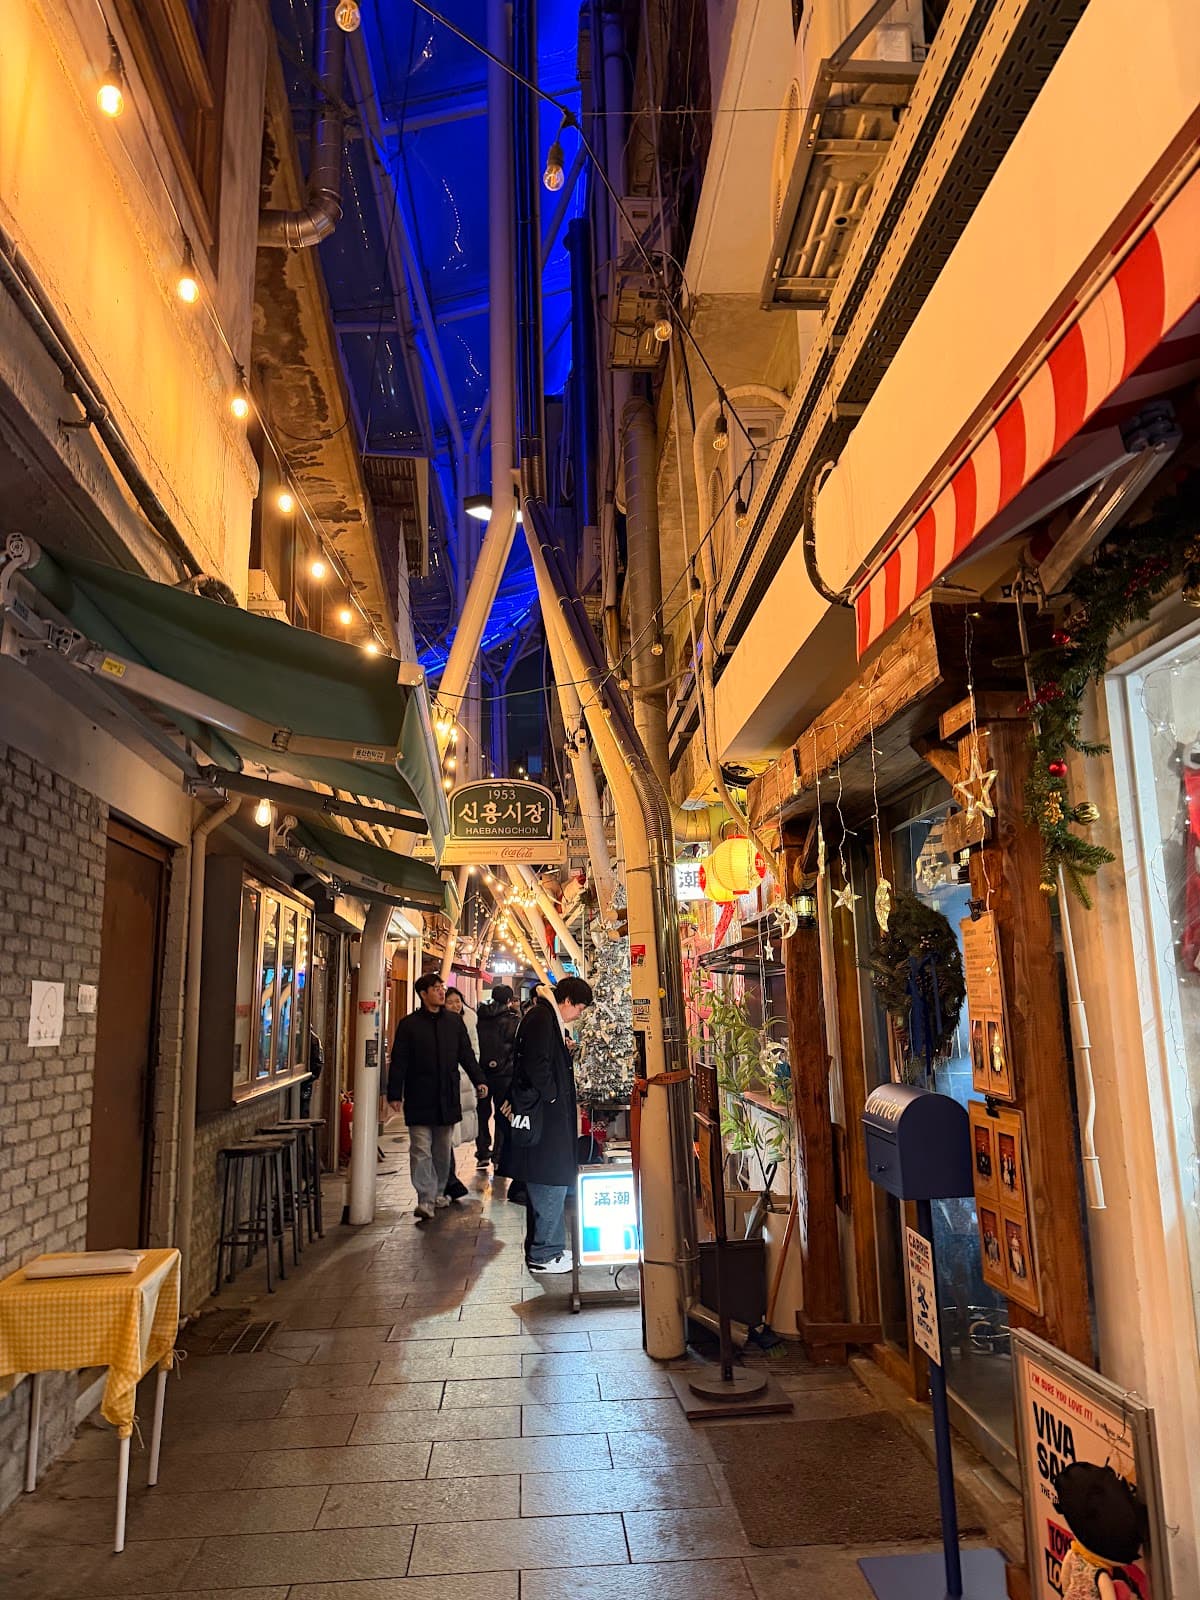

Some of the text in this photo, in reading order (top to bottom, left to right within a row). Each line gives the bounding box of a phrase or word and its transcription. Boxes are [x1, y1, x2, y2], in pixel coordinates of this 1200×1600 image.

[488, 789, 516, 801] 1953
[458, 801, 546, 825] 신흥시장
[465, 827, 539, 835] HAEBANGCHON
[1041, 1377, 1055, 1396] SURE
[1056, 1387, 1067, 1404] YOU
[1068, 1396, 1083, 1416] LOVE
[1032, 1401, 1076, 1464] VIVA
